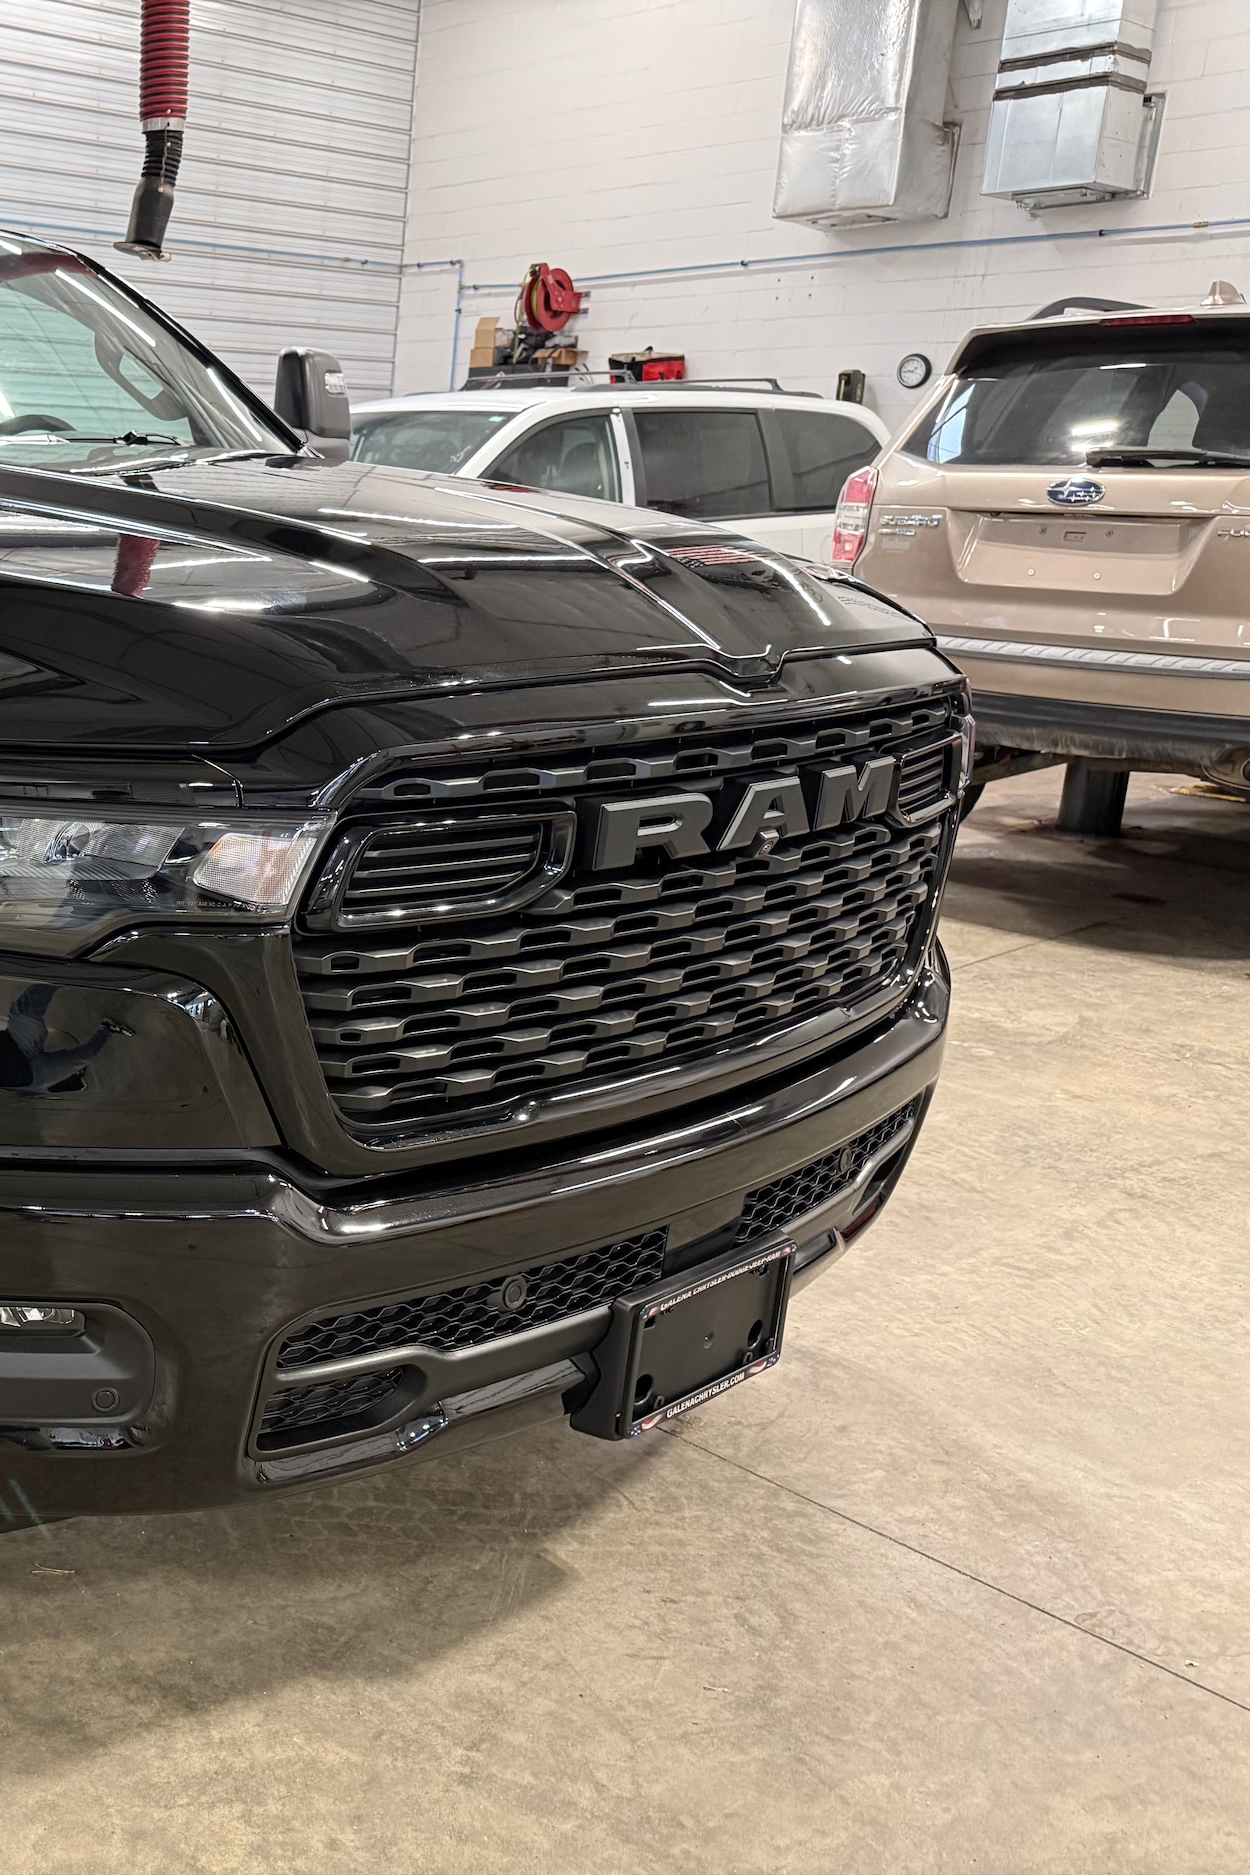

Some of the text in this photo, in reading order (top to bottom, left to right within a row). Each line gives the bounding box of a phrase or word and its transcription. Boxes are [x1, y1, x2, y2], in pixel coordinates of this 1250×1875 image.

[879, 514, 943, 527] SUBARU
[592, 755, 896, 871] RAM
[660, 1290, 692, 1312] GALENA
[666, 1372, 745, 1418] GALENACHRYSLER.COM
